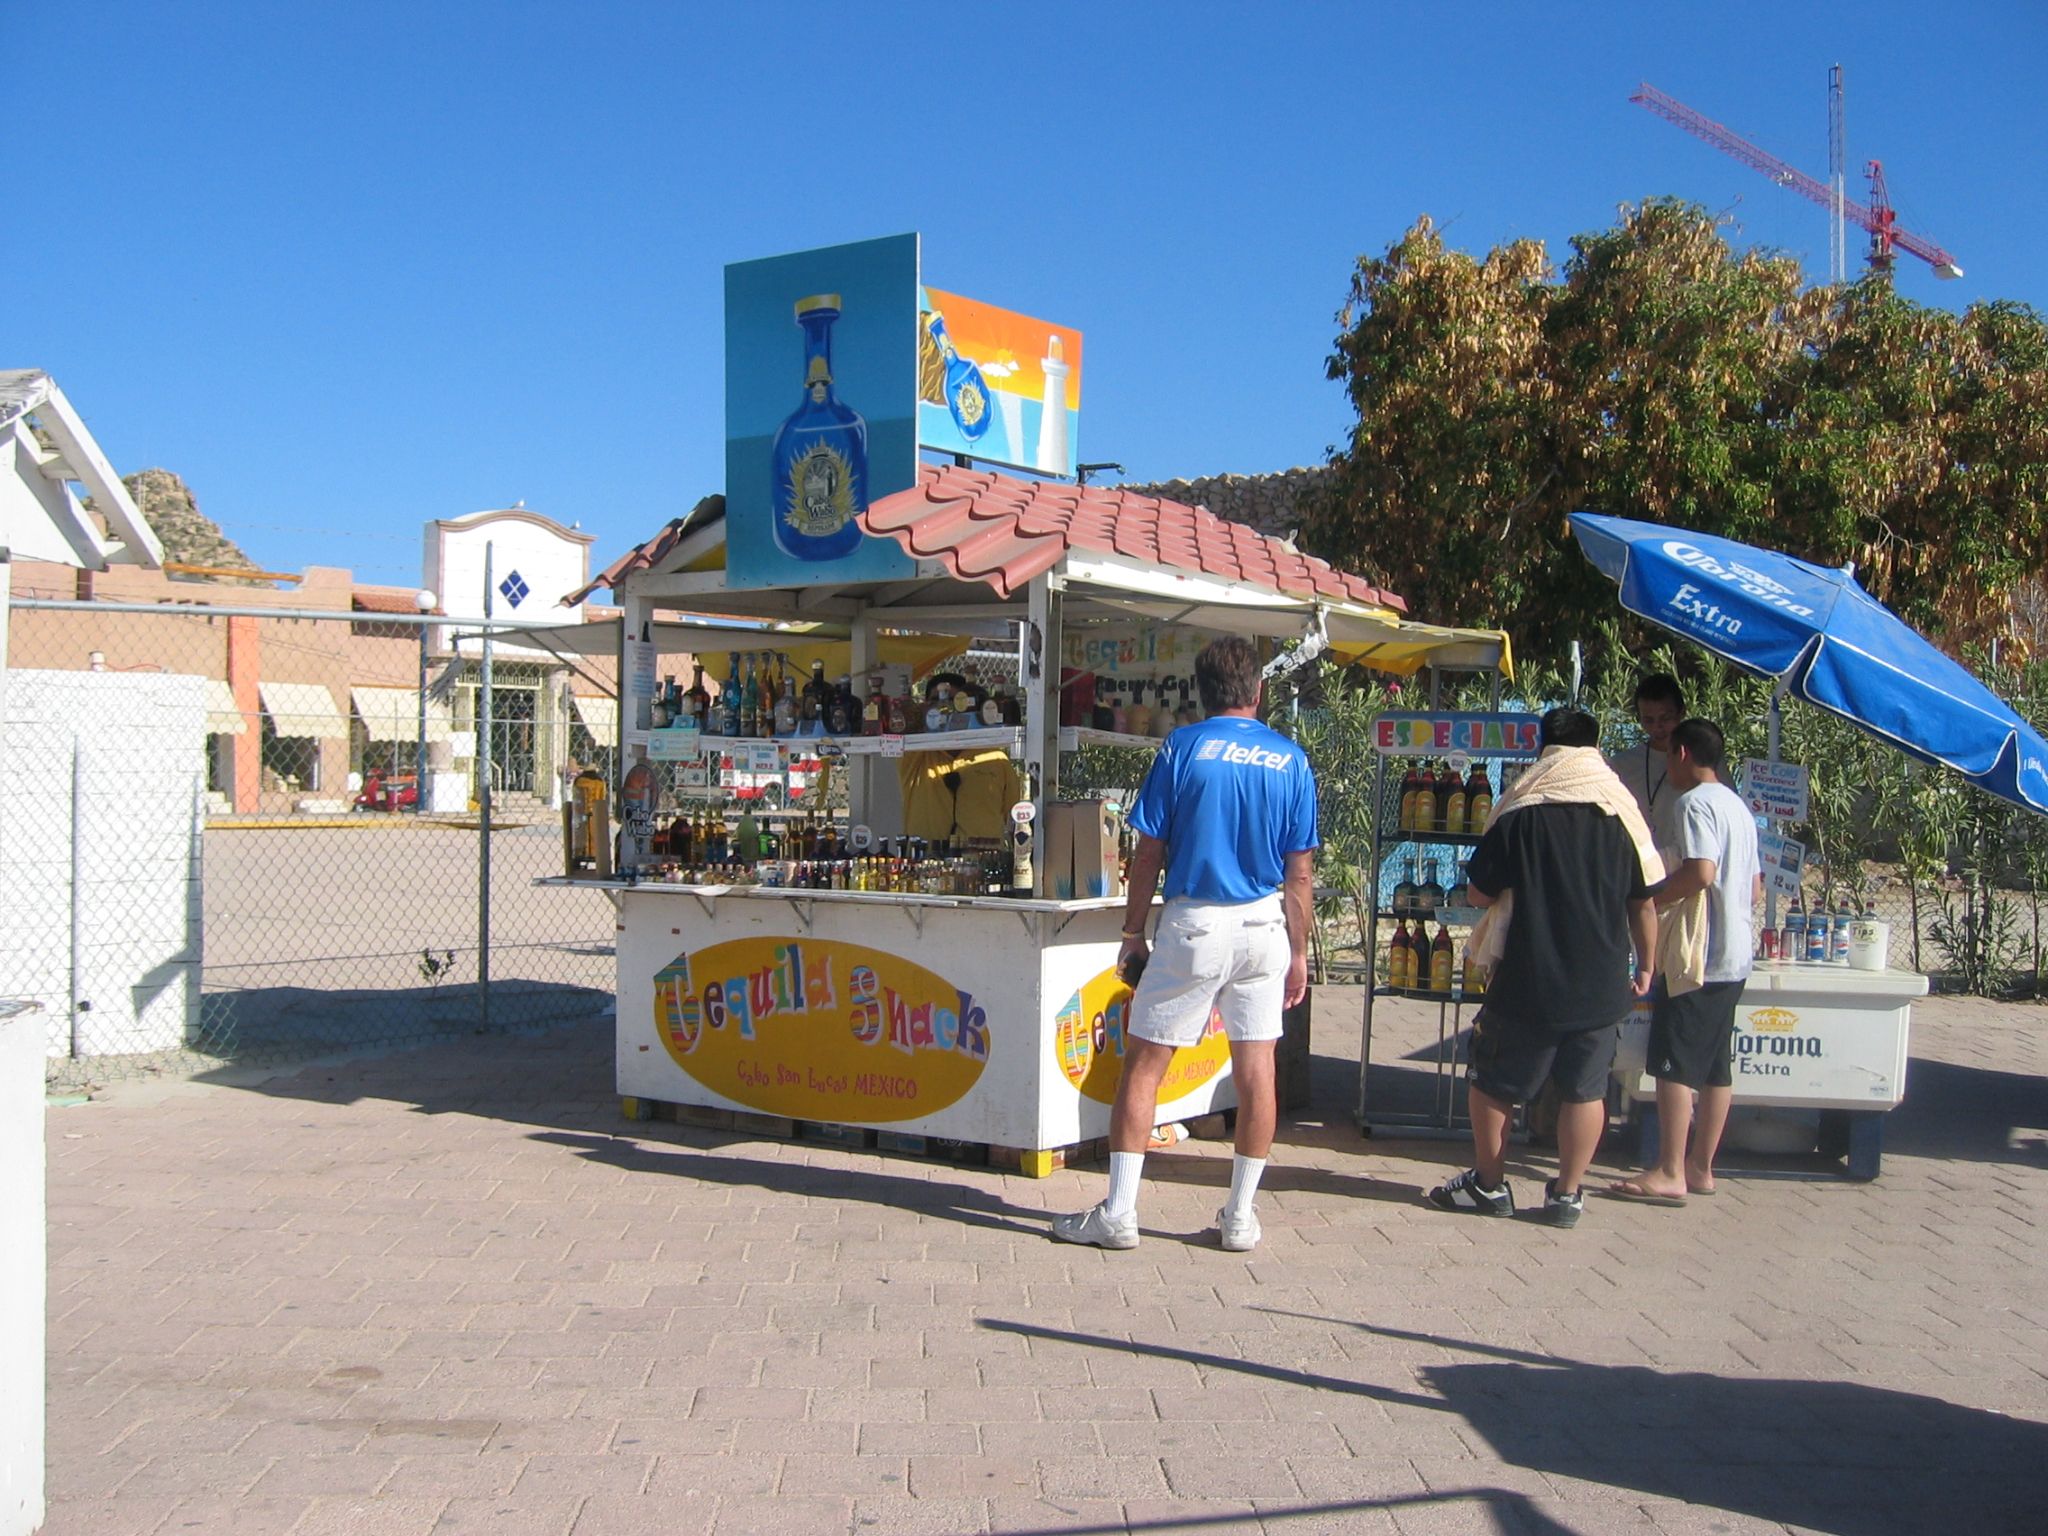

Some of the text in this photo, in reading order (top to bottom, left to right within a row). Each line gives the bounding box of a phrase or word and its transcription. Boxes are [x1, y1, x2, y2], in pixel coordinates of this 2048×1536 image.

[1663, 541, 1815, 617] Corona
[1669, 583, 1743, 636] Extra
[1065, 622, 1176, 672] Tequila
[1377, 719, 1540, 751] ESPECIALS
[1222, 742, 1292, 771] telcel
[1750, 761, 1769, 774] Ice
[1747, 791, 1800, 805] & Sodas
[623, 805, 650, 821] Cabo
[624, 819, 656, 837] Wabo
[1852, 926, 1875, 938] Tips
[654, 943, 837, 1054] Tequila
[849, 964, 990, 1063] Shack
[736, 1059, 918, 1099] Cabo San Lucas MEXICO
[1184, 1059, 1216, 1082] MEXICO
[1739, 1057, 1791, 1077] Extra
